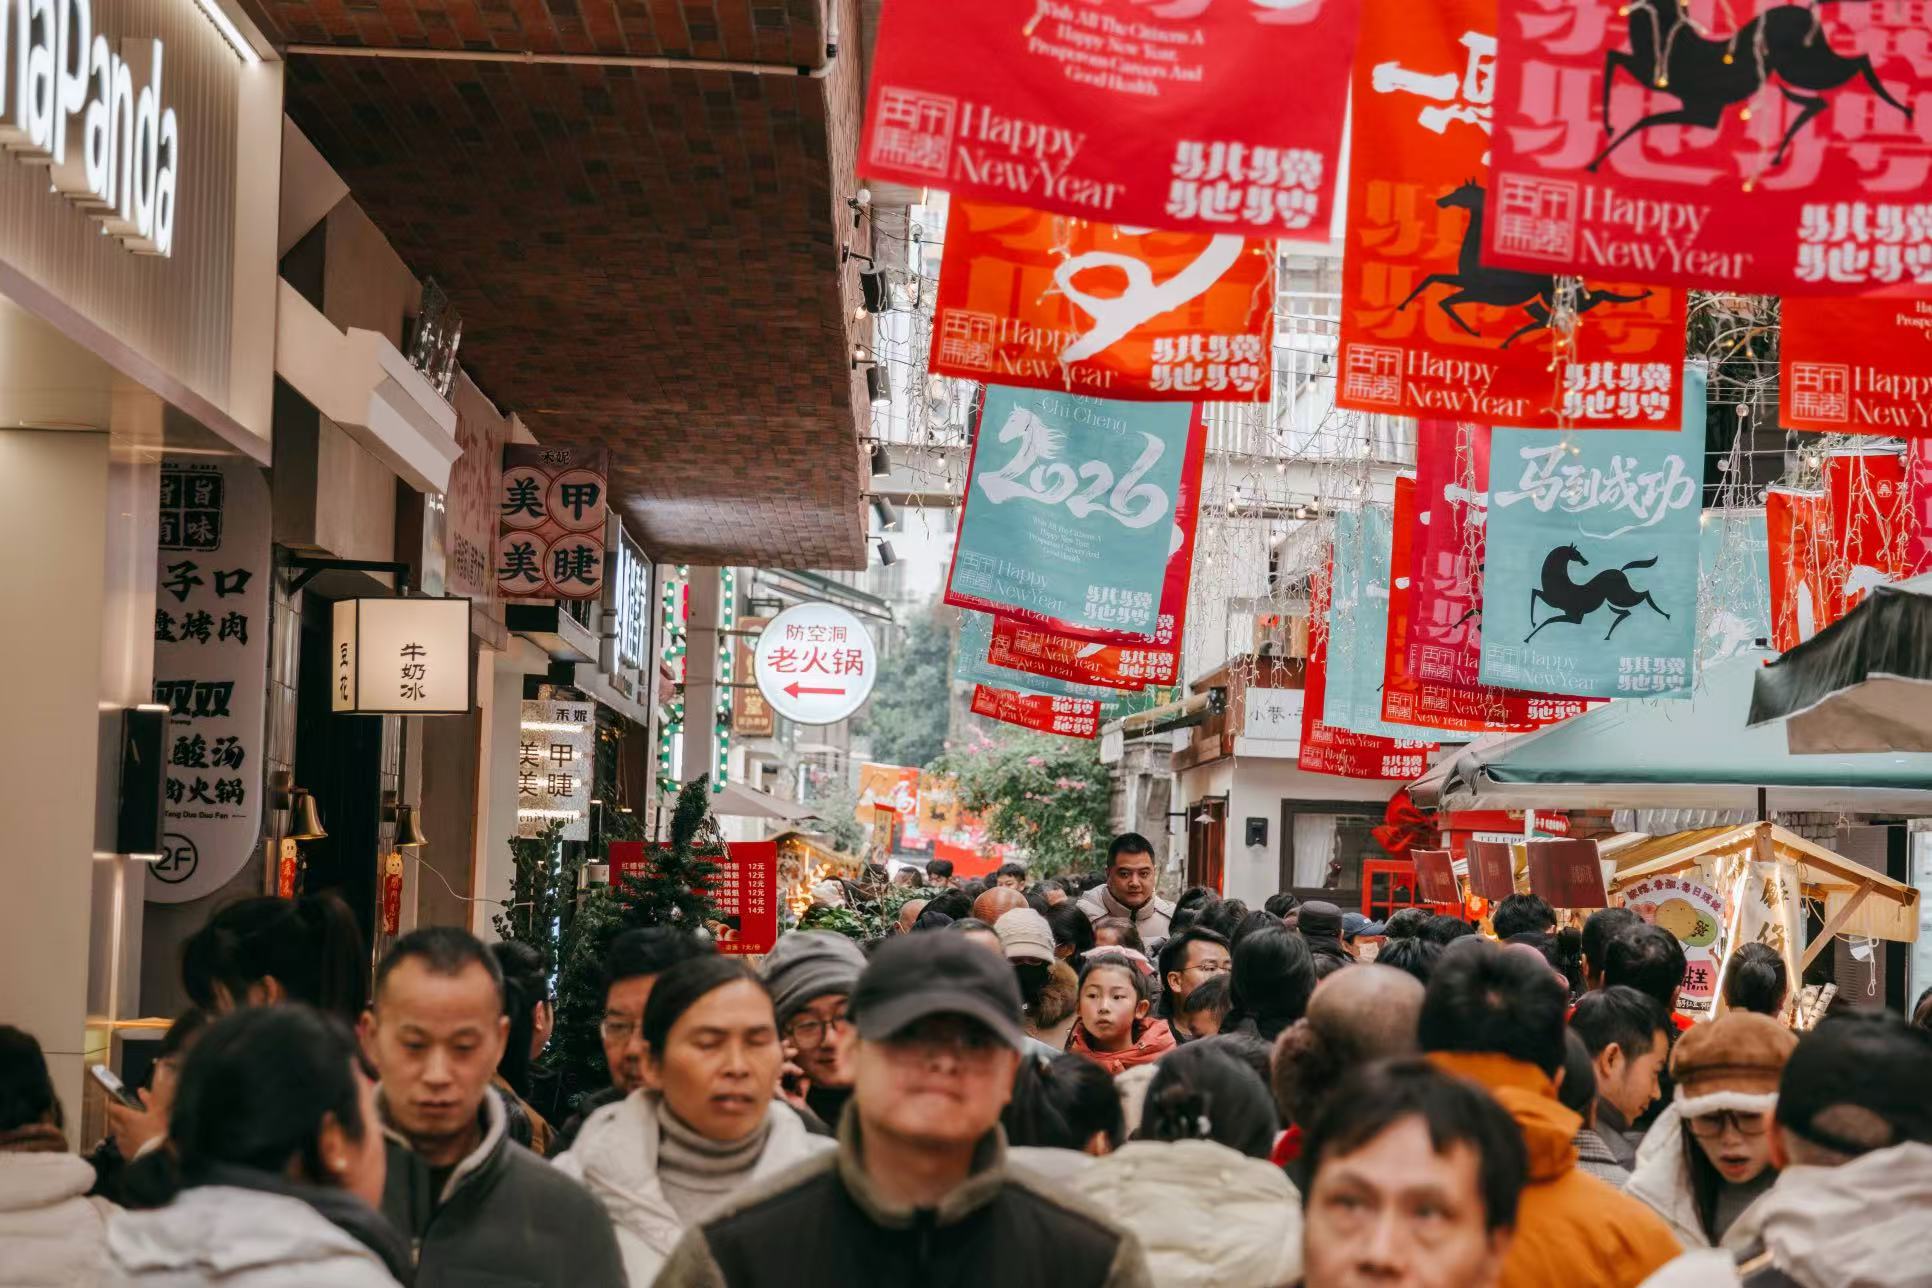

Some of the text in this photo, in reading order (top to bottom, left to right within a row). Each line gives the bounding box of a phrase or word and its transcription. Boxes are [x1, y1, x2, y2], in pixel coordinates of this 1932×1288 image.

[960, 102, 1087, 159] Happy
[1582, 185, 1711, 237] Happy
[1408, 350, 1499, 388] Happy
[1073, 405, 1128, 435] Cheng
[978, 402, 1169, 529] 2026
[501, 477, 601, 521] 美甲
[1494, 444, 1697, 536] 马到成功
[498, 542, 600, 586] 美睫
[998, 560, 1049, 591] Happy
[786, 624, 847, 643] 防空洞
[400, 642, 427, 701] 牛奶冰
[767, 646, 864, 677] 老火锅
[1523, 648, 1578, 672] Happy
[519, 741, 573, 768] 美甲
[518, 771, 573, 797] 美睫
[155, 847, 191, 871] 2F
